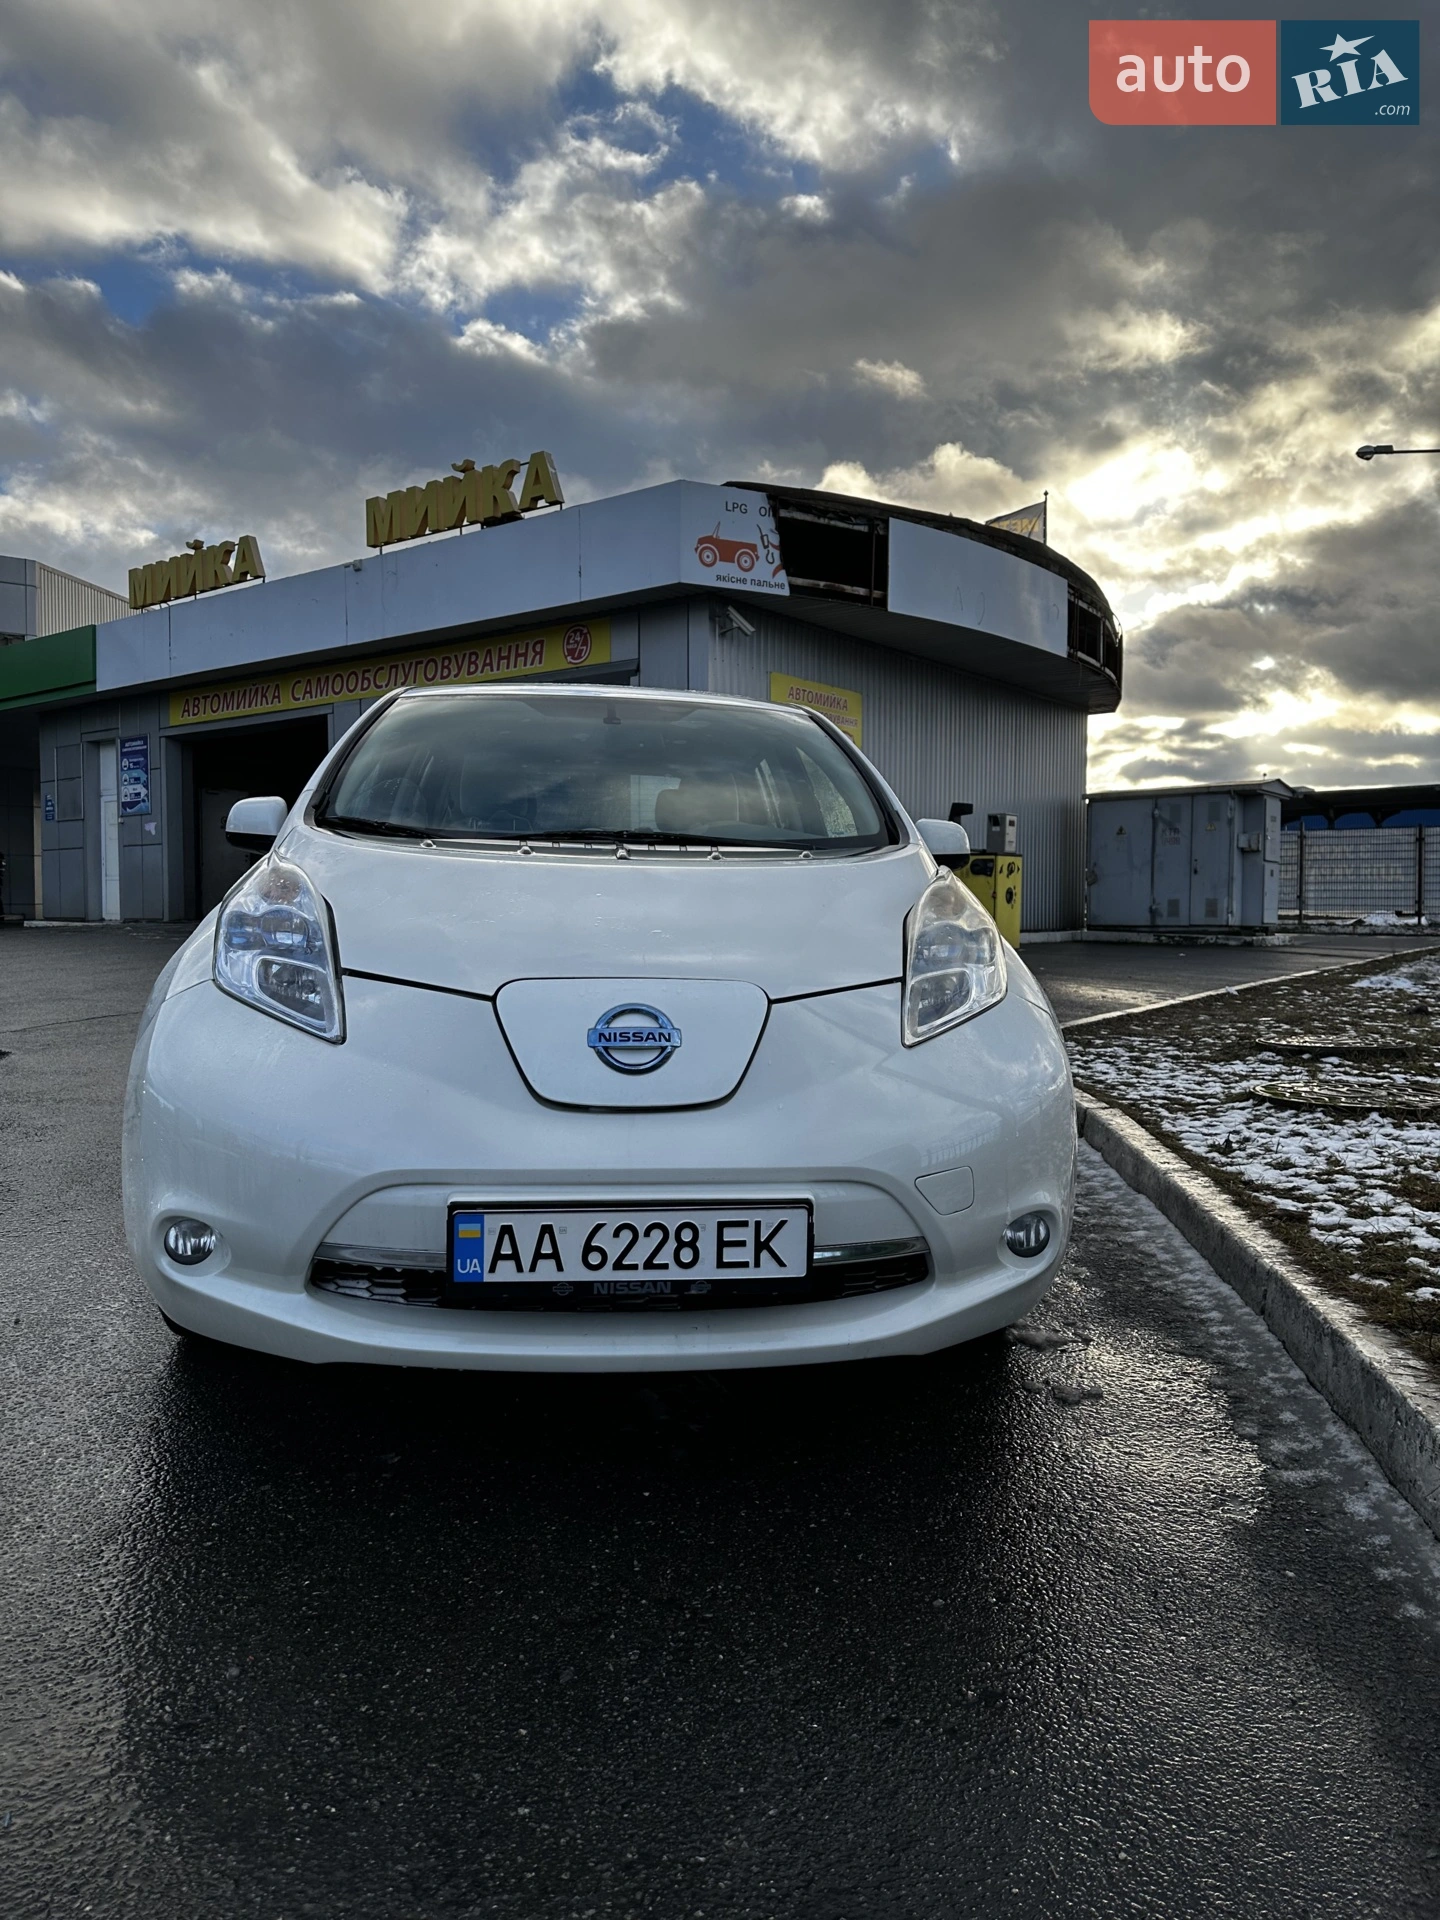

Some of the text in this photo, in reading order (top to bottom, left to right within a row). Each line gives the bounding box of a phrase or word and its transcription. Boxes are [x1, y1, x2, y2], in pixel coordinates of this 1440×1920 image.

[366, 451, 565, 548] МИЙКА
[725, 500, 748, 514] LPG
[129, 535, 266, 609] МИЙКА
[715, 573, 786, 590] якісне пальне
[180, 638, 546, 719] АВТОМИЙКА САМООБСЛУГОВУВАННЯ
[788, 686, 848, 712] АВТОМИЙКА
[598, 1032, 672, 1043] NISSAN
[488, 1219, 789, 1274] AA 6228 EK
[457, 1258, 482, 1274] UA
[594, 1281, 672, 1295] NISSAN
